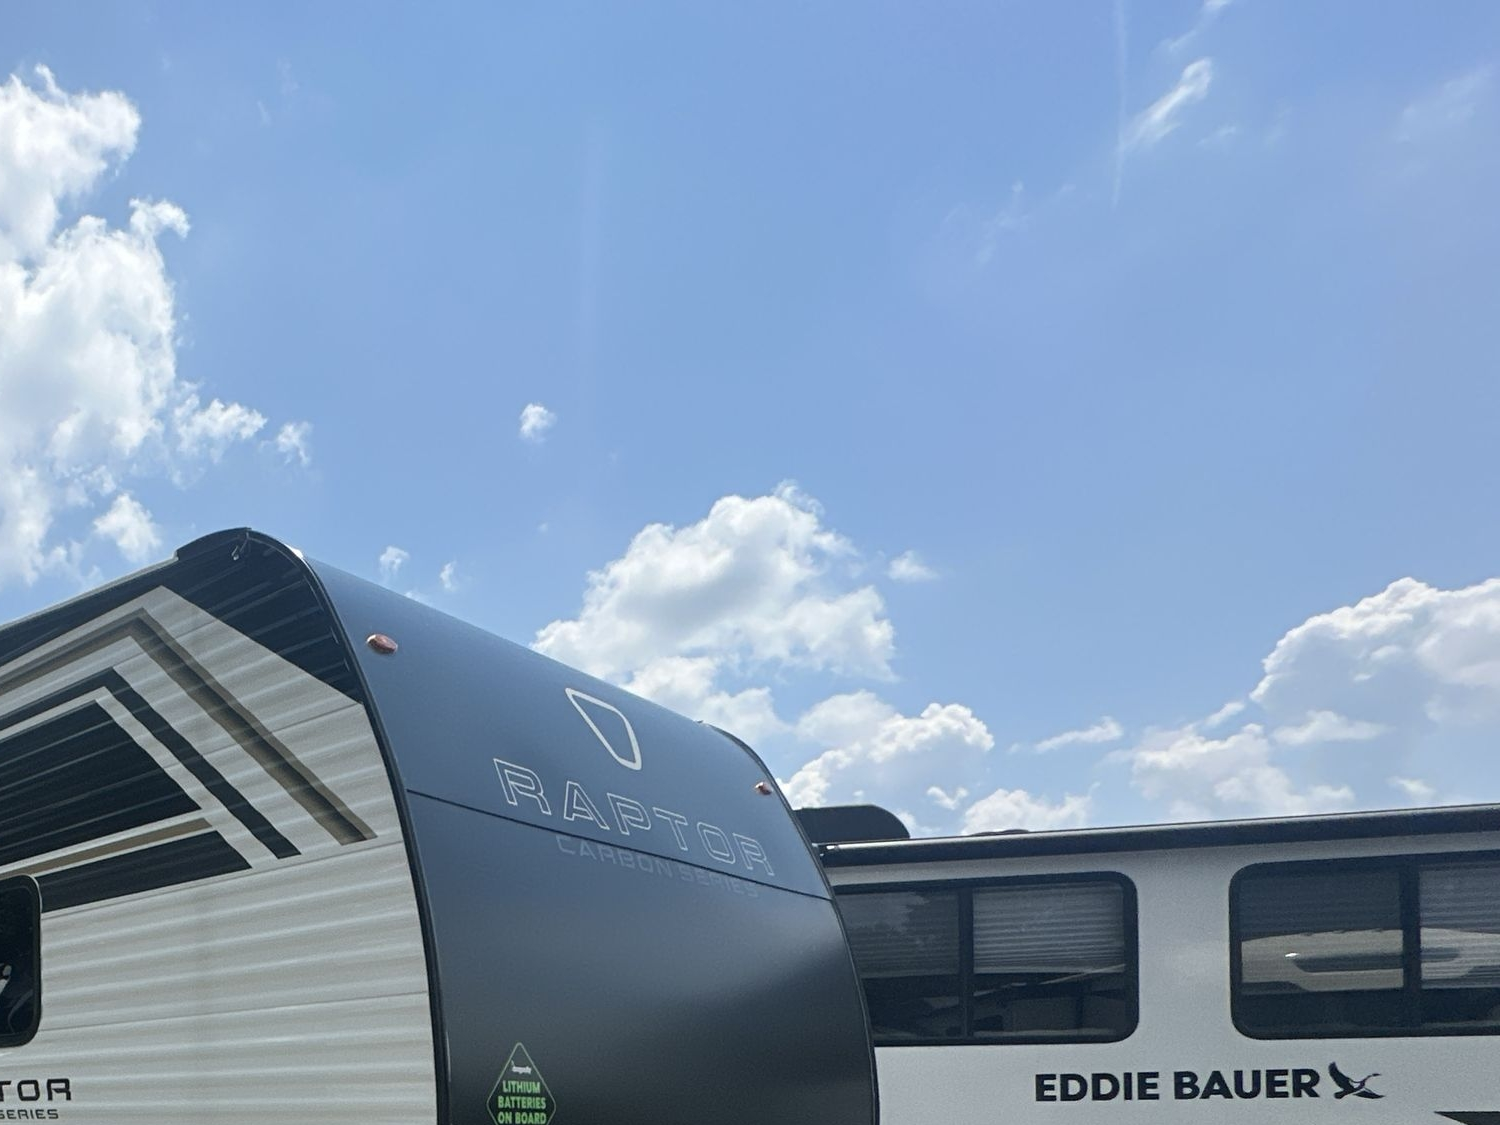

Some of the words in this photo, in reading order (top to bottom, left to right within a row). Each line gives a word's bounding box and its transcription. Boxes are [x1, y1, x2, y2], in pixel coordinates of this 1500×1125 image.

[493, 757, 775, 877] RAPTOR
[556, 835, 673, 878] CARBON
[675, 864, 759, 898] SERIES
[502, 1080, 541, 1093] LITHIUM
[1034, 1071, 1160, 1102] EDDIE
[1174, 1067, 1321, 1100] BAUER
[498, 1095, 546, 1109] BATTERIES
[497, 1111, 513, 1124] ON
[515, 1112, 547, 1124] BOARD
